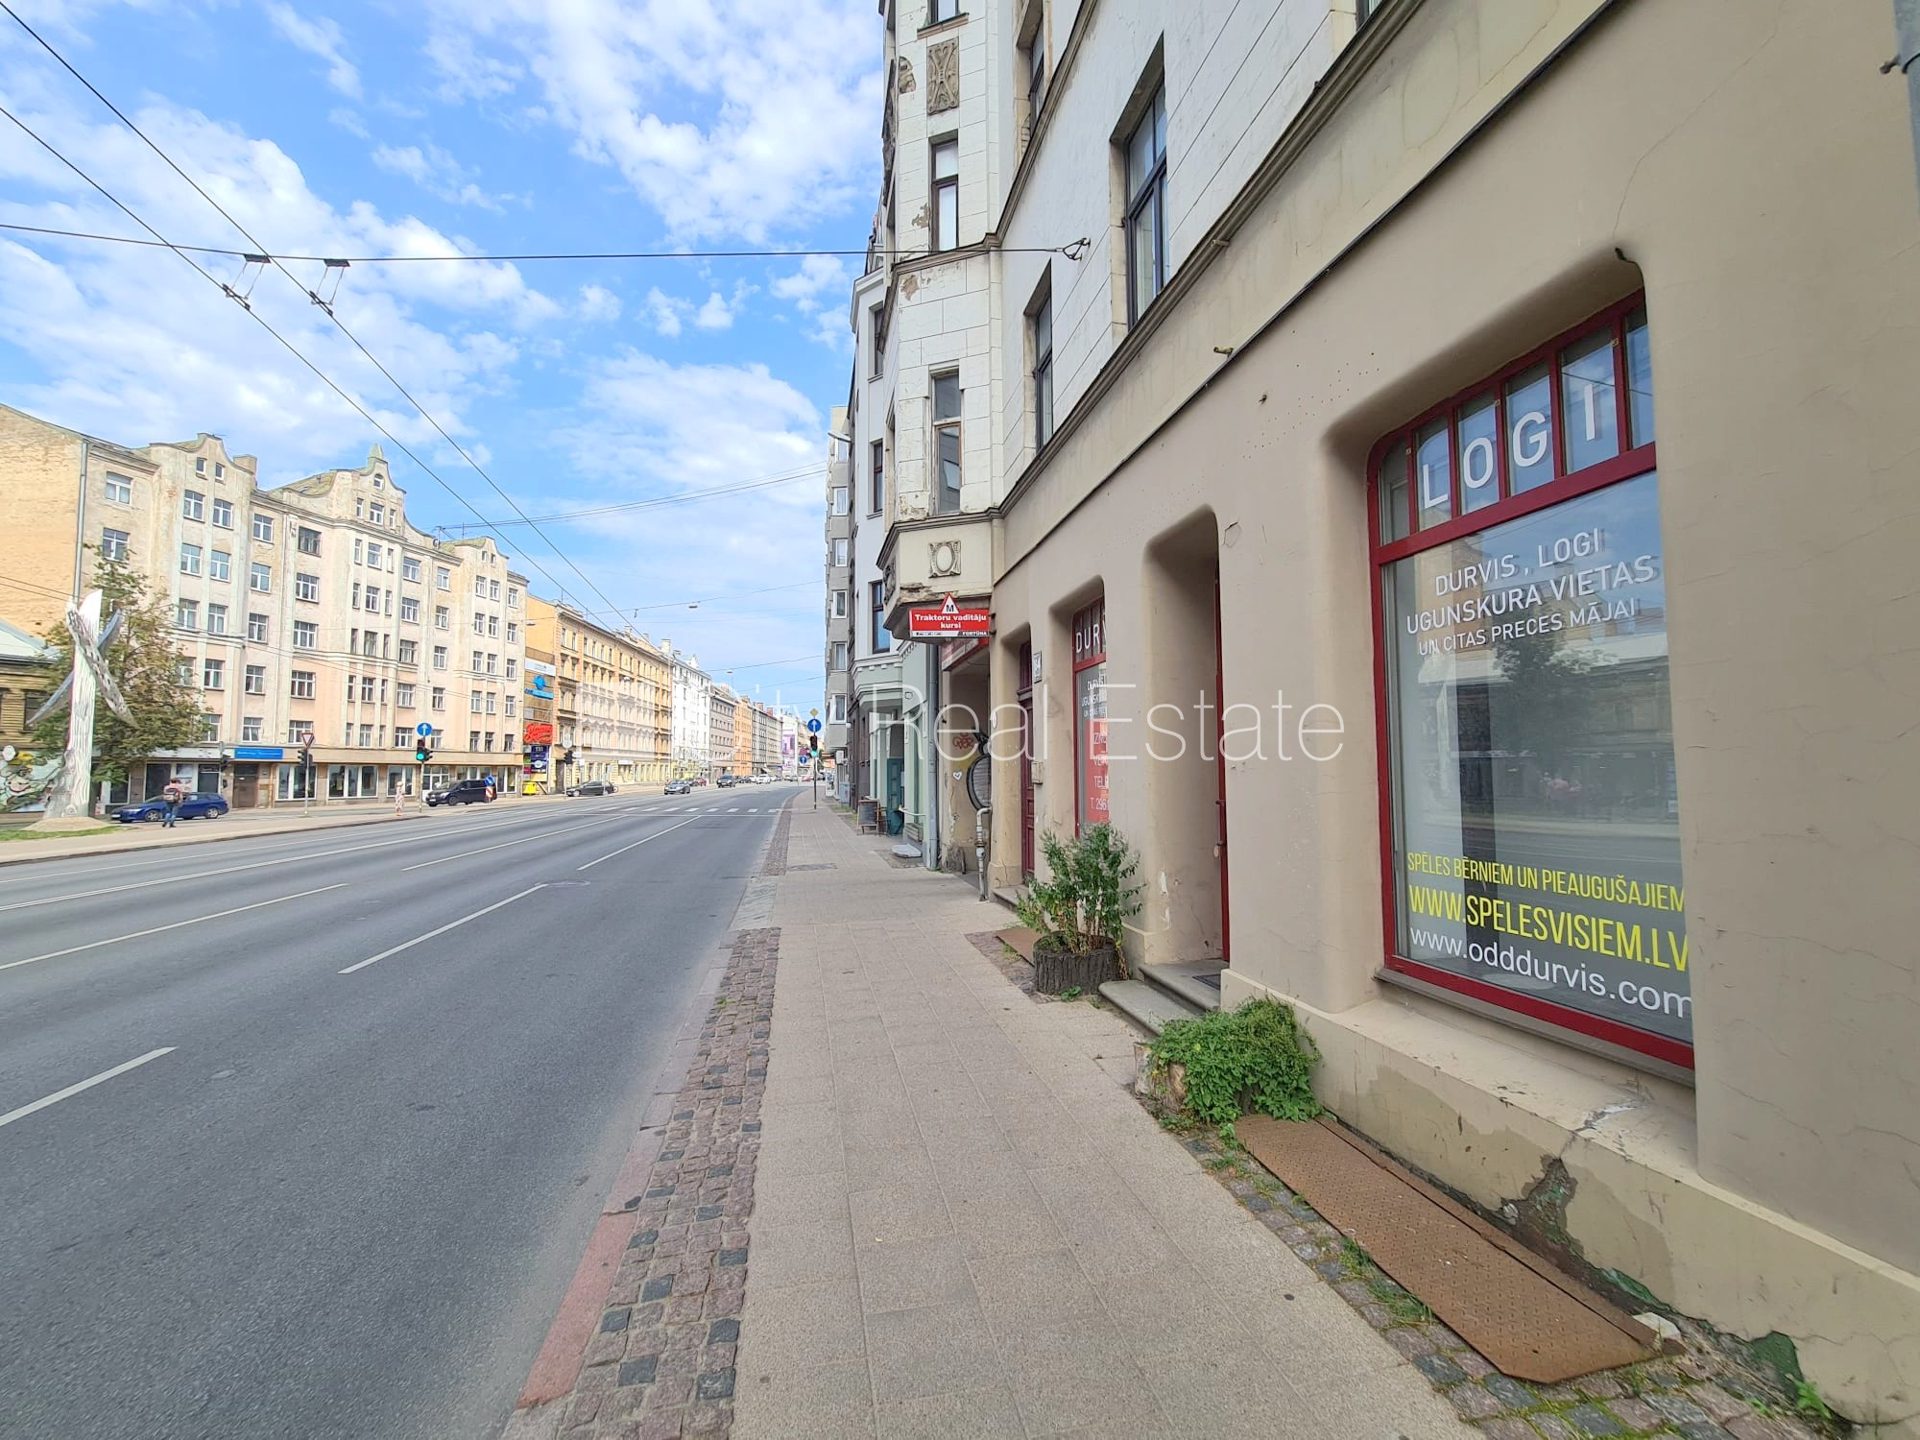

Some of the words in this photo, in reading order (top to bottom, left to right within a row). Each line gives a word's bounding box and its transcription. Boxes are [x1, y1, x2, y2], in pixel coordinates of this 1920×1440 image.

[1422, 384, 1596, 508] LOGI
[1538, 528, 1600, 567] LOGI
[953, 614, 987, 622] vadītāju
[1407, 584, 1542, 634] UGUNSKURA
[1550, 555, 1655, 603] VIETAS
[1418, 638, 1440, 656] UN
[1443, 629, 1487, 651] CITAS
[1491, 612, 1563, 642] PRECES
[1569, 597, 1635, 628] MĀJAI
[1407, 851, 1451, 876] SPĒLES
[1453, 856, 1514, 886] BĒRNIEM
[1517, 865, 1538, 889] UN
[1542, 869, 1685, 912] PIEAUGUŠAJIEM
[1408, 884, 1689, 972] WWW.SPELESVISIEM.LV
[1410, 926, 1692, 1018] www.odddurvis.com
